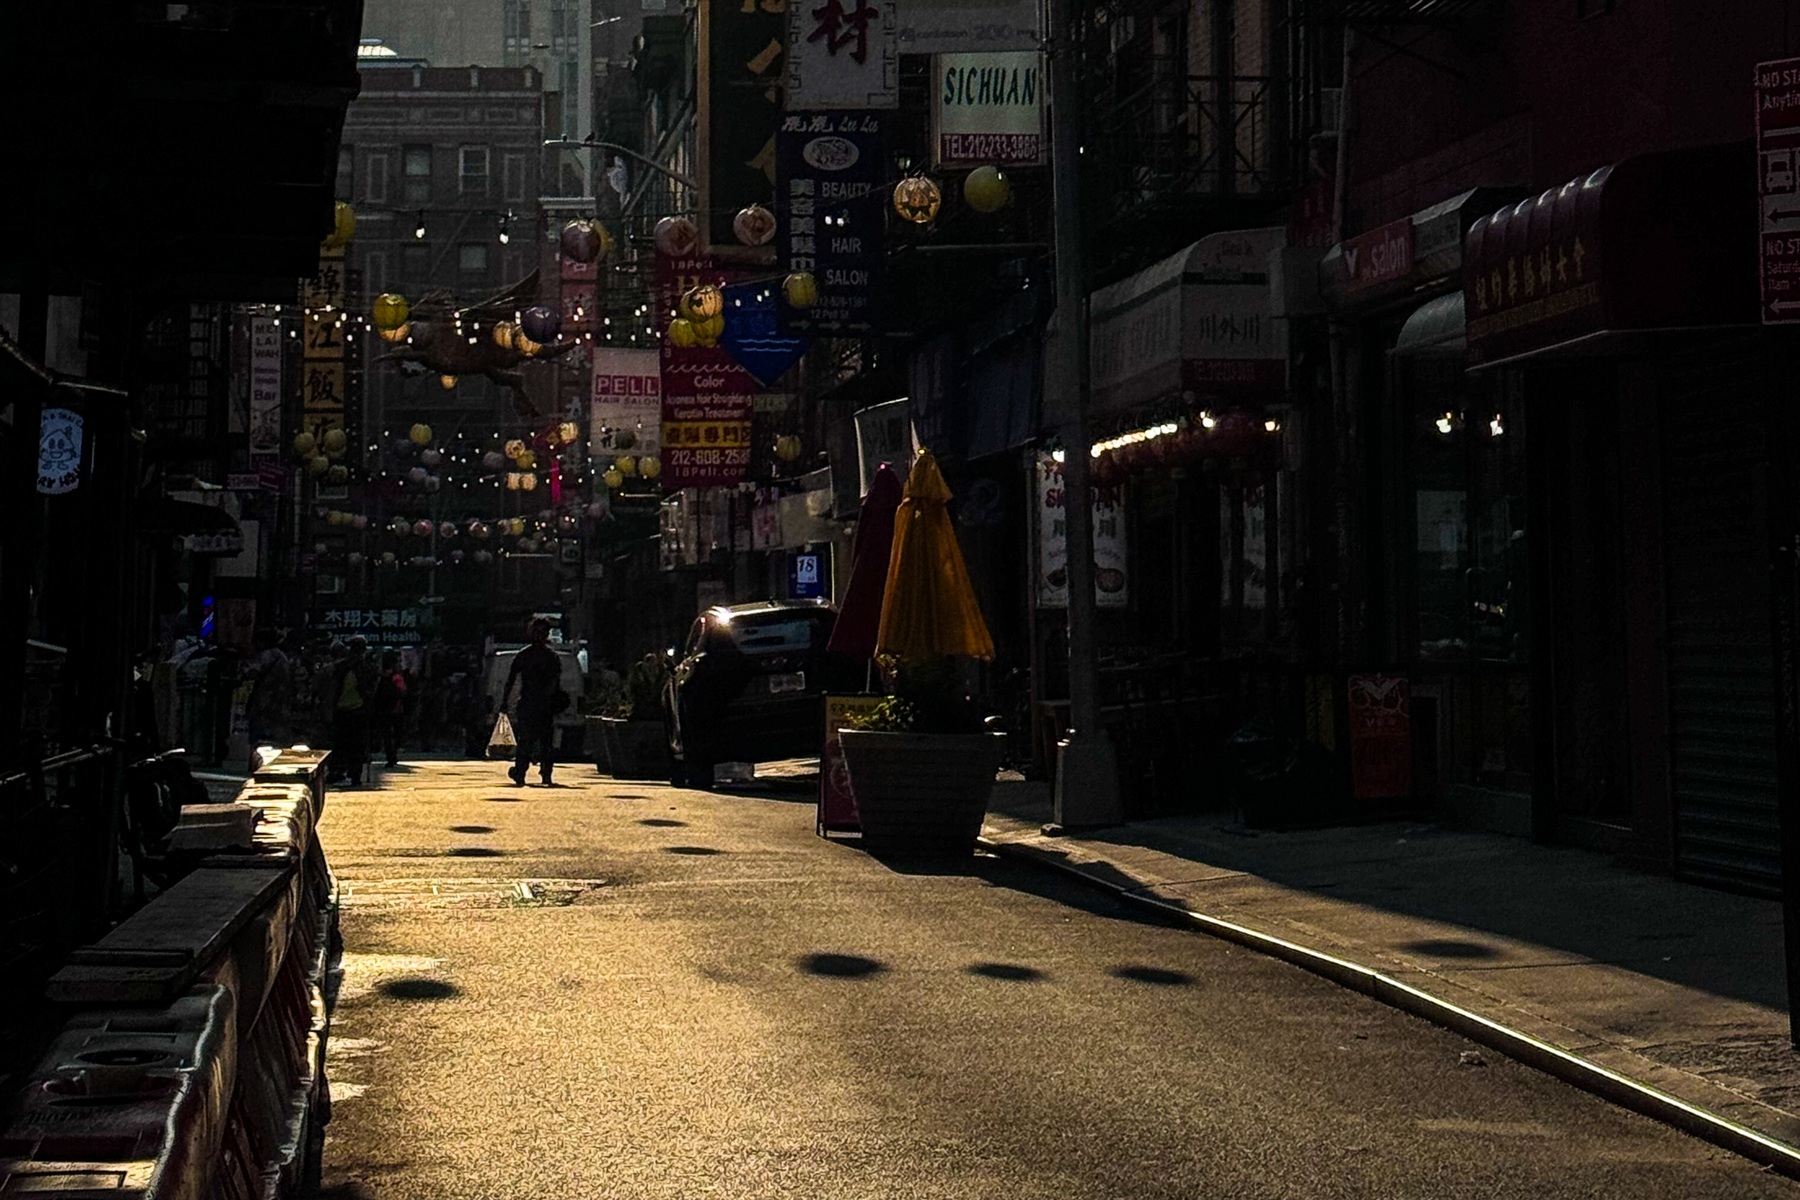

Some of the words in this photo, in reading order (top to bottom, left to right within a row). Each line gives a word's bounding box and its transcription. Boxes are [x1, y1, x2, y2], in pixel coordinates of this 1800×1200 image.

[944, 66, 1036, 106] SICHUAN
[1762, 71, 1780, 88] NO
[821, 182, 872, 198] BEAUTY
[831, 237, 862, 254] HAIR
[1371, 229, 1407, 278] salon
[1766, 239, 1784, 256] NO
[826, 269, 869, 286] SALON
[597, 377, 658, 395] PELL
[693, 375, 725, 388] Color
[799, 558, 815, 573] 18
[382, 631, 421, 642] Health
